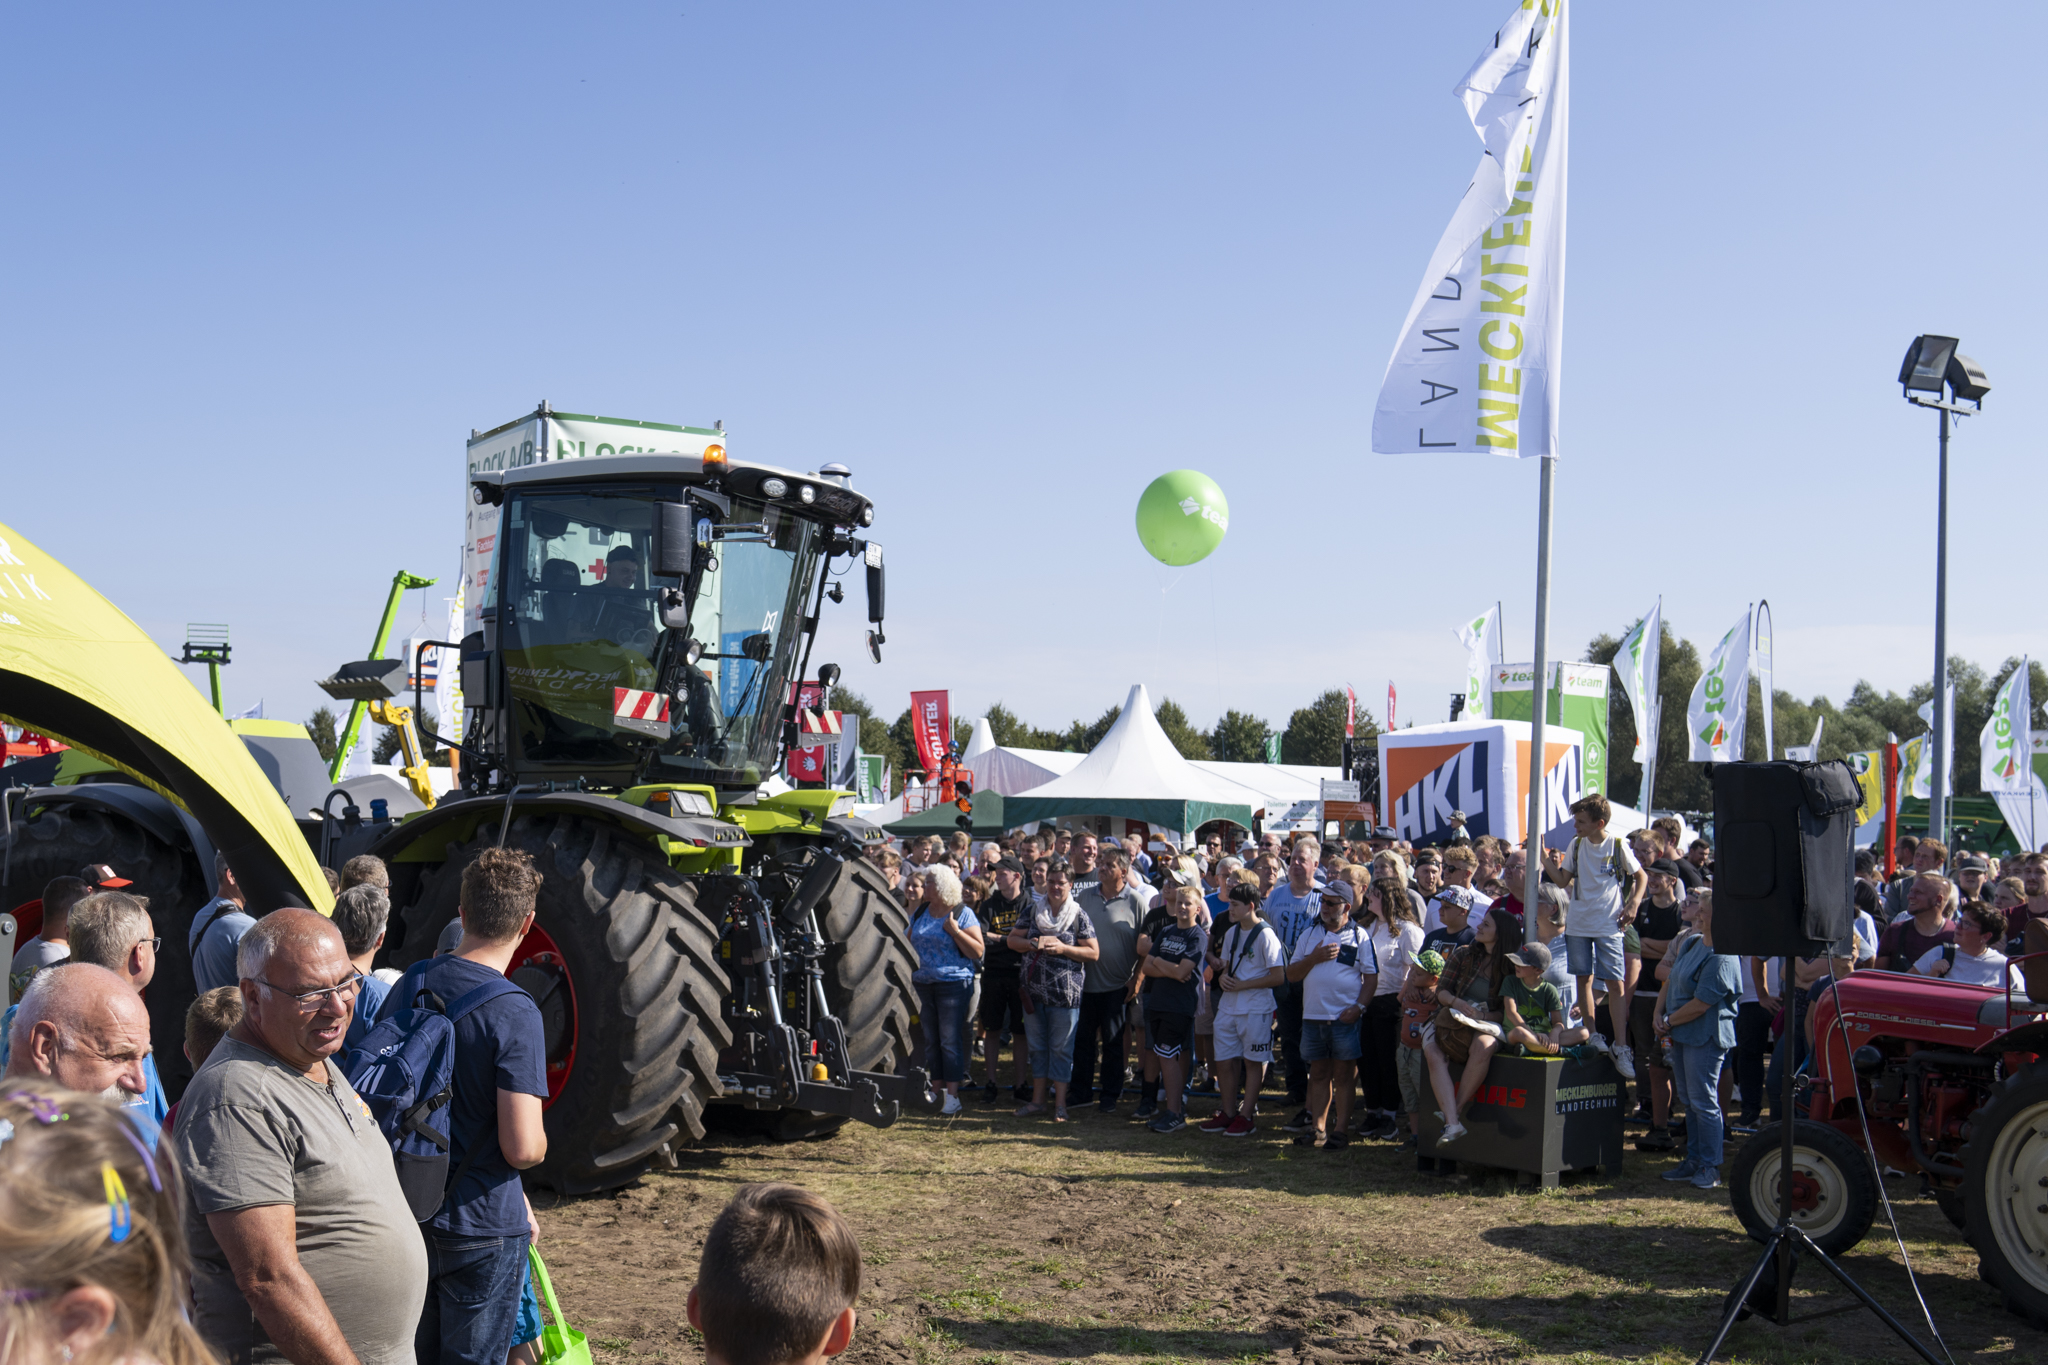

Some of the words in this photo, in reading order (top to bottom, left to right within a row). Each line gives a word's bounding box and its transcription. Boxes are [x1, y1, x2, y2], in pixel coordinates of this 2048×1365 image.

[1512, 669, 1549, 682] tea
[1577, 677, 1602, 689] team
[1395, 743, 1483, 842] HKL
[1857, 1011, 1900, 1021] PORSCHE
[1905, 1017, 1939, 1027] DIESEL
[1855, 1023, 1870, 1032] 22
[1251, 1043, 1268, 1052] JUST
[1455, 1081, 1527, 1108] AAS
[1555, 1083, 1617, 1102] MECKLENBURGER
[1555, 1098, 1617, 1114] LANDTECHNIK
